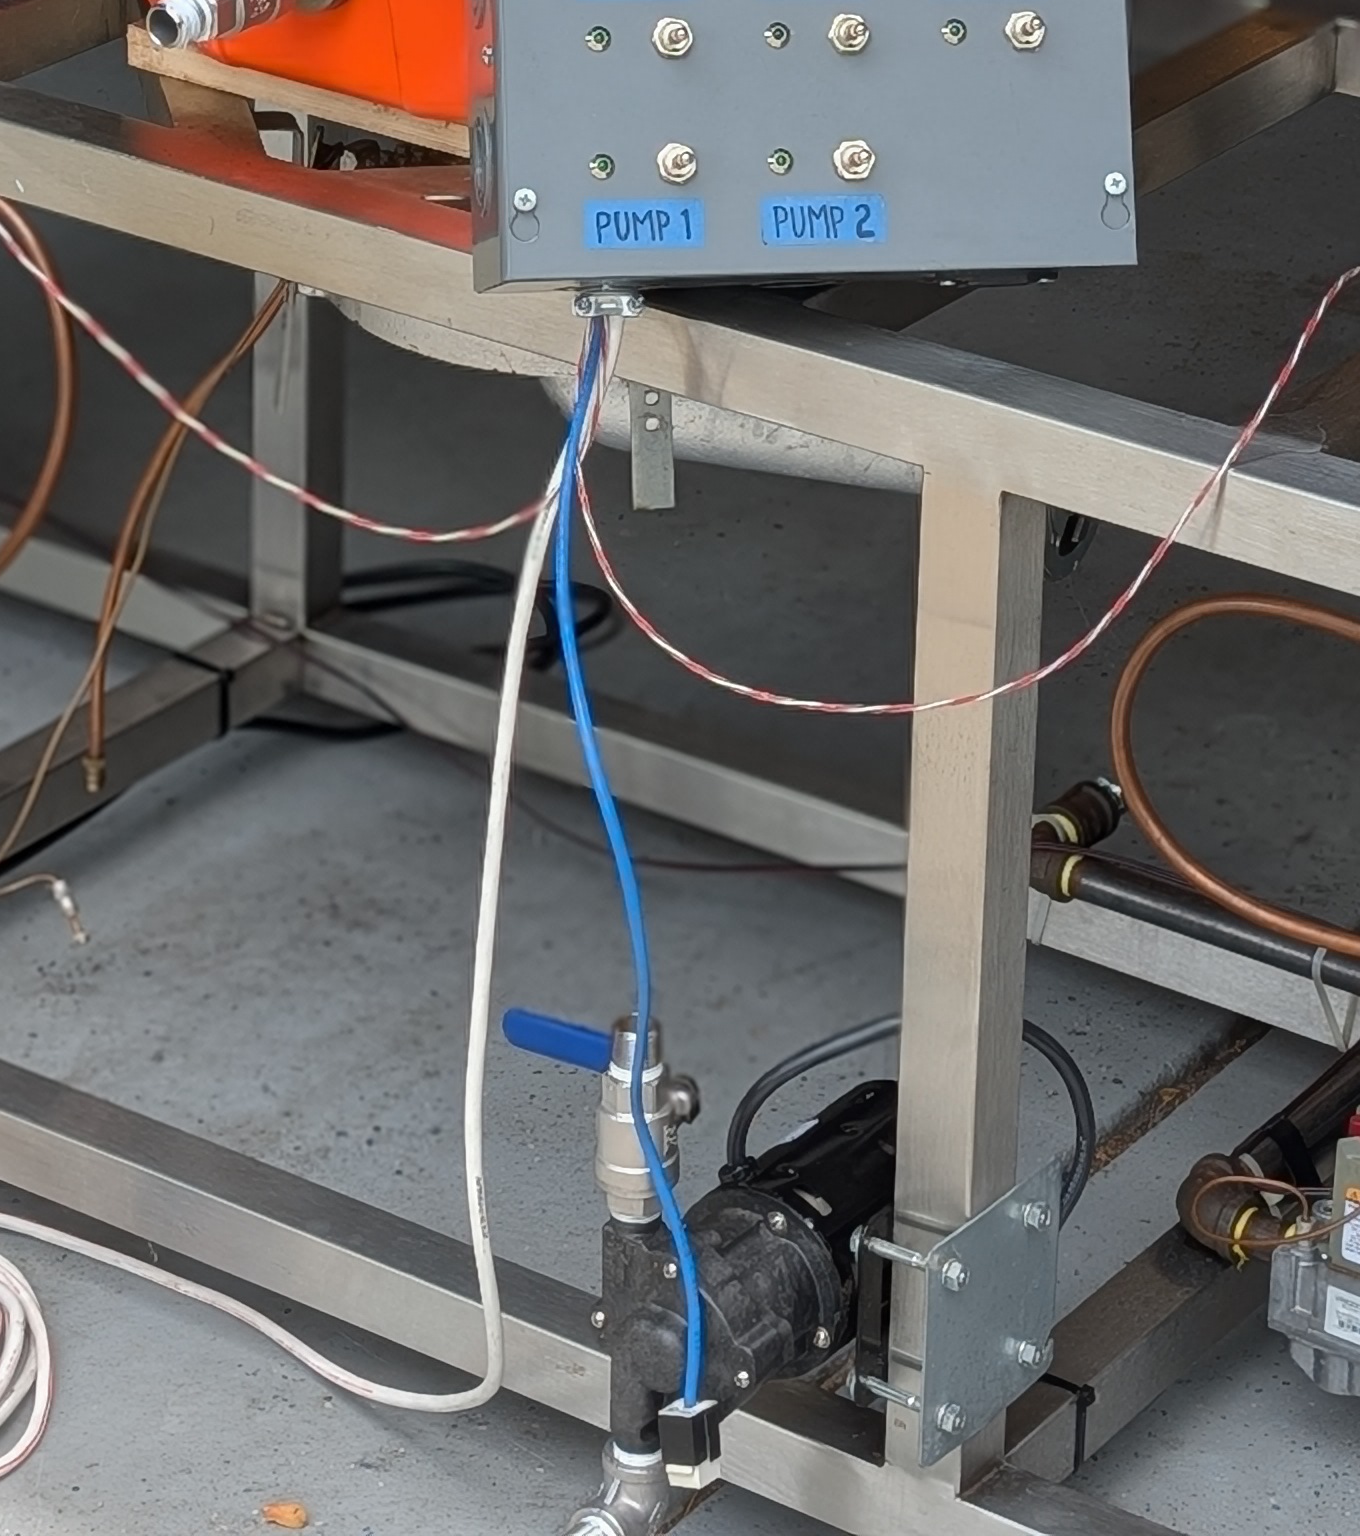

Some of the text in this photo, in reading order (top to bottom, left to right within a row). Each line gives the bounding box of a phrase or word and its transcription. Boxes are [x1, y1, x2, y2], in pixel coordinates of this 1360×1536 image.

[595, 211, 693, 244] PUMP 1
[773, 204, 877, 240] PUMP 2
